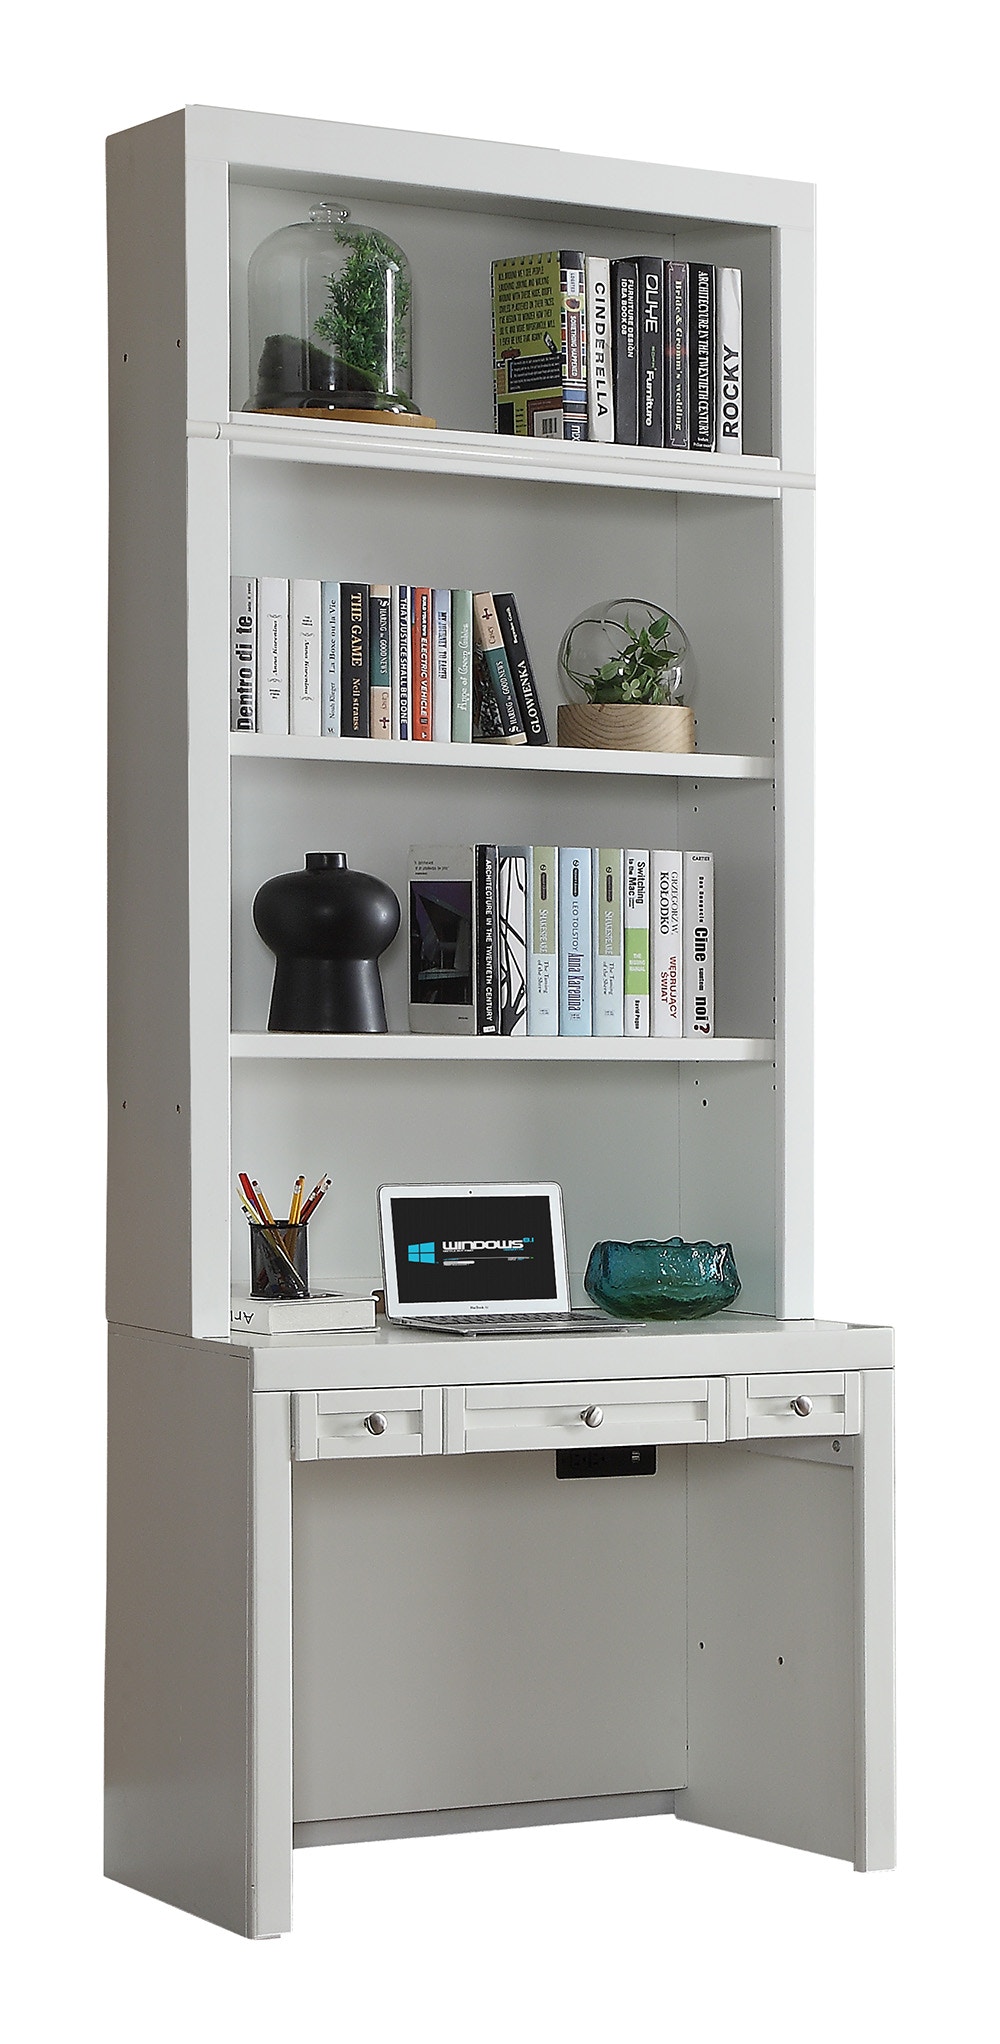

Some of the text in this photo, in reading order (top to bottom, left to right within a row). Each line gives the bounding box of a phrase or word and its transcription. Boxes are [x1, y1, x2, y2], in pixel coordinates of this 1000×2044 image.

[674, 280, 682, 312] Bride
[627, 279, 636, 358] FURNITURE DESIGN
[676, 314, 682, 326] &
[594, 282, 609, 418] CINDERELLA
[698, 340, 710, 356] THE
[698, 356, 710, 400] TWENTIETH
[722, 344, 739, 438] ROCKY
[674, 384, 684, 431] wedding
[699, 400, 710, 437] CENTURY
[329, 616, 336, 624] la
[331, 626, 336, 637] ou
[351, 592, 363, 667] THE GAME
[235, 616, 254, 730] Dentro di te
[329, 662, 336, 674] La
[352, 678, 360, 730] Neil strauss
[400, 687, 408, 699] BE
[636, 862, 645, 904] Switching
[660, 872, 669, 934] KOŁODKO
[486, 918, 492, 926] IN
[671, 923, 678, 935] W.
[568, 953, 584, 972] Anna
[694, 927, 708, 962] Cine
[568, 975, 584, 1011] Karenina
[661, 971, 669, 1003] ŚWIAT
[668, 956, 677, 1019] WĘDRUJĄCY
